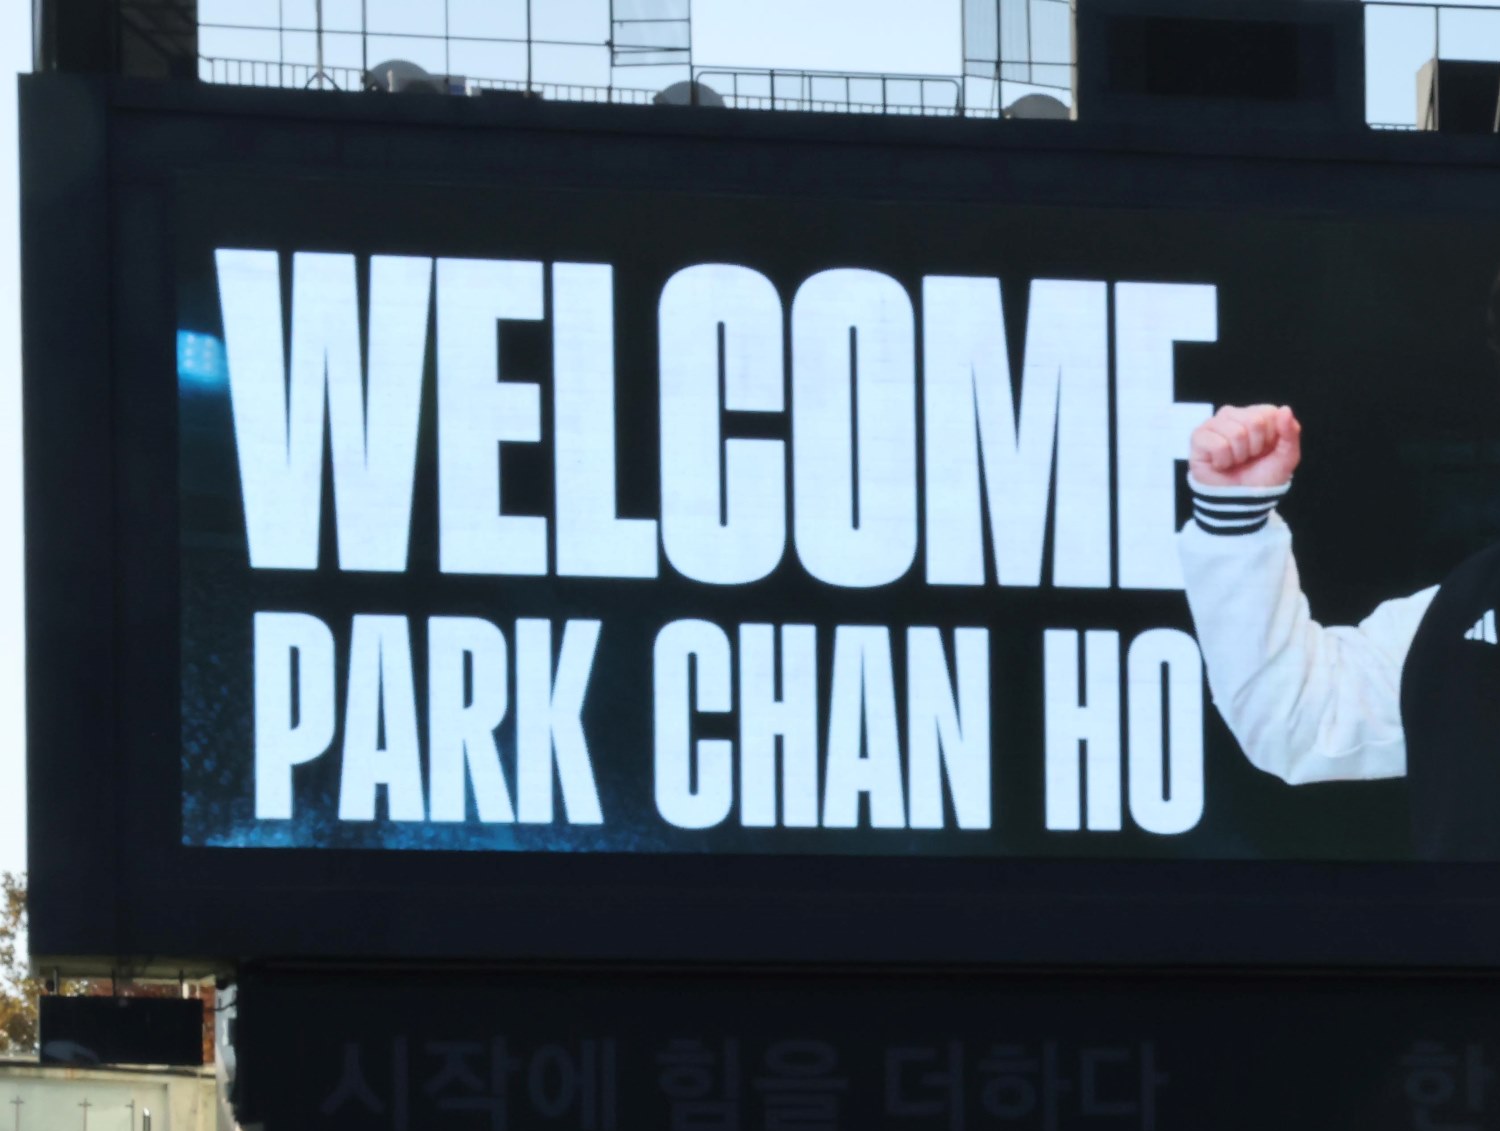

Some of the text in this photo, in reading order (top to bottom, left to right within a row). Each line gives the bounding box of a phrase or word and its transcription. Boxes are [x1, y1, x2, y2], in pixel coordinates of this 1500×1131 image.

[214, 248, 1218, 591] WELCOME
[252, 611, 1205, 836] PARK CHAN HO
